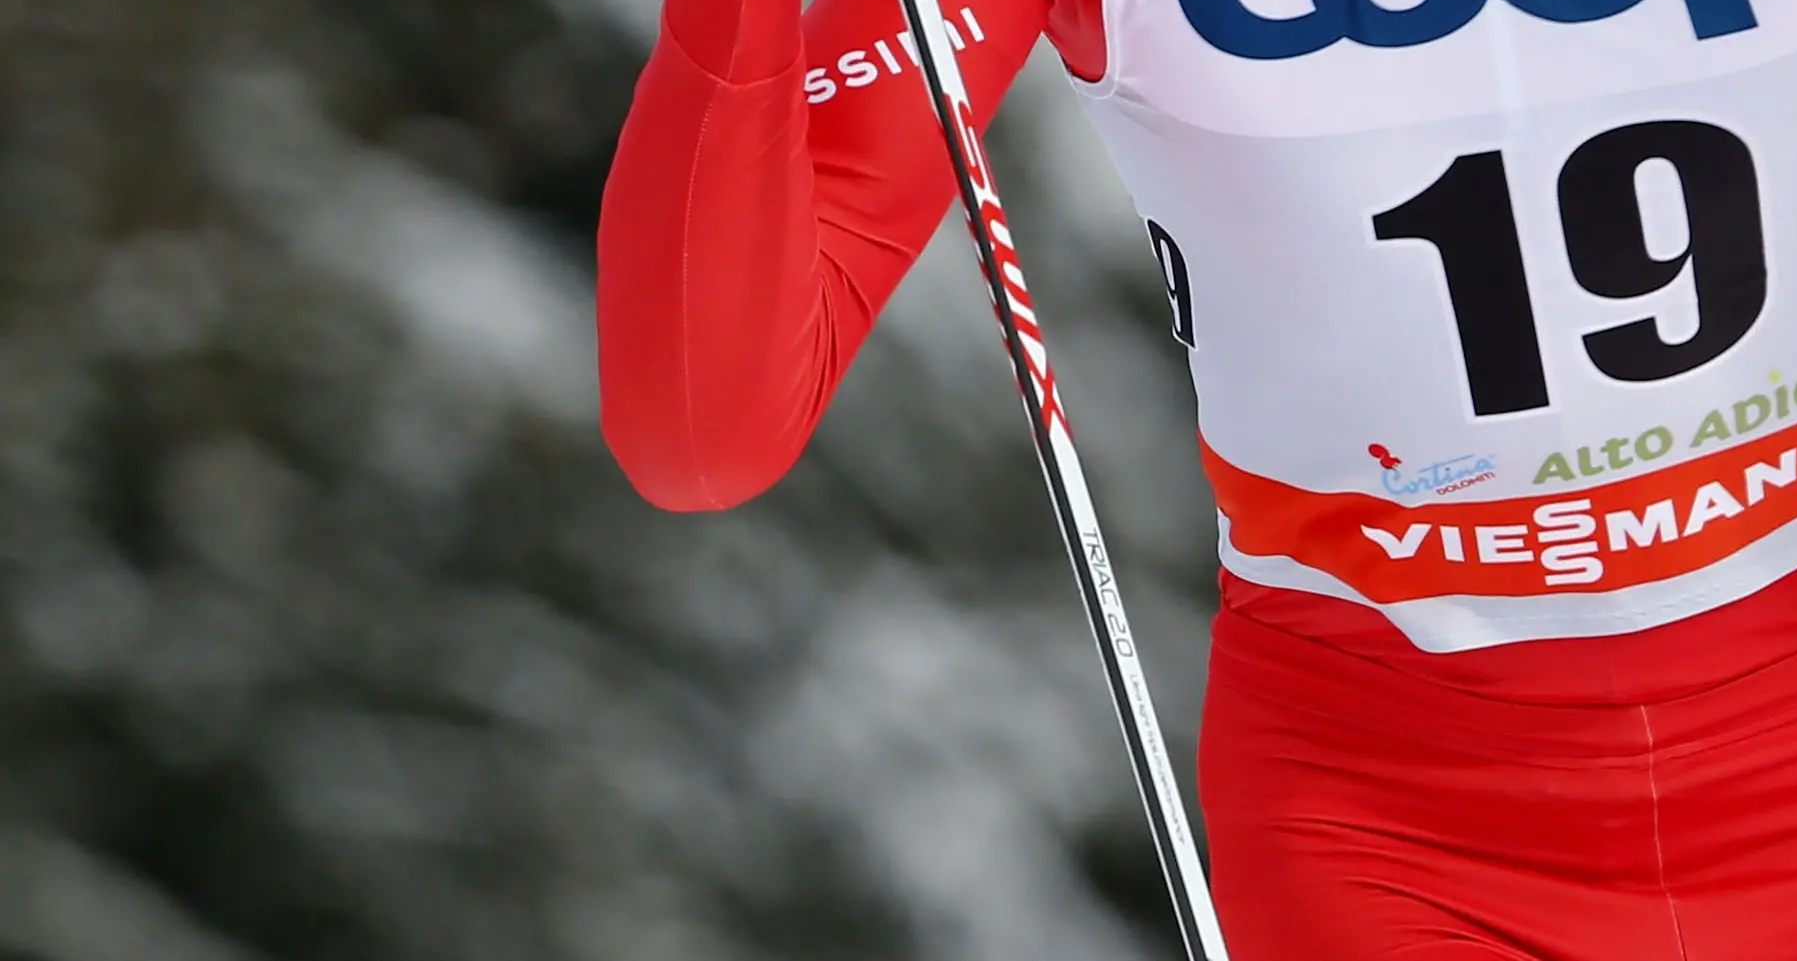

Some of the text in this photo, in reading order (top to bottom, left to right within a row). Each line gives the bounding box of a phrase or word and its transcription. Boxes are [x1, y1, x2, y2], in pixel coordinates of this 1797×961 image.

[1371, 119, 1768, 417] 19
[1382, 453, 1496, 495] Cortina
[1083, 527, 1120, 608] TRIAC
